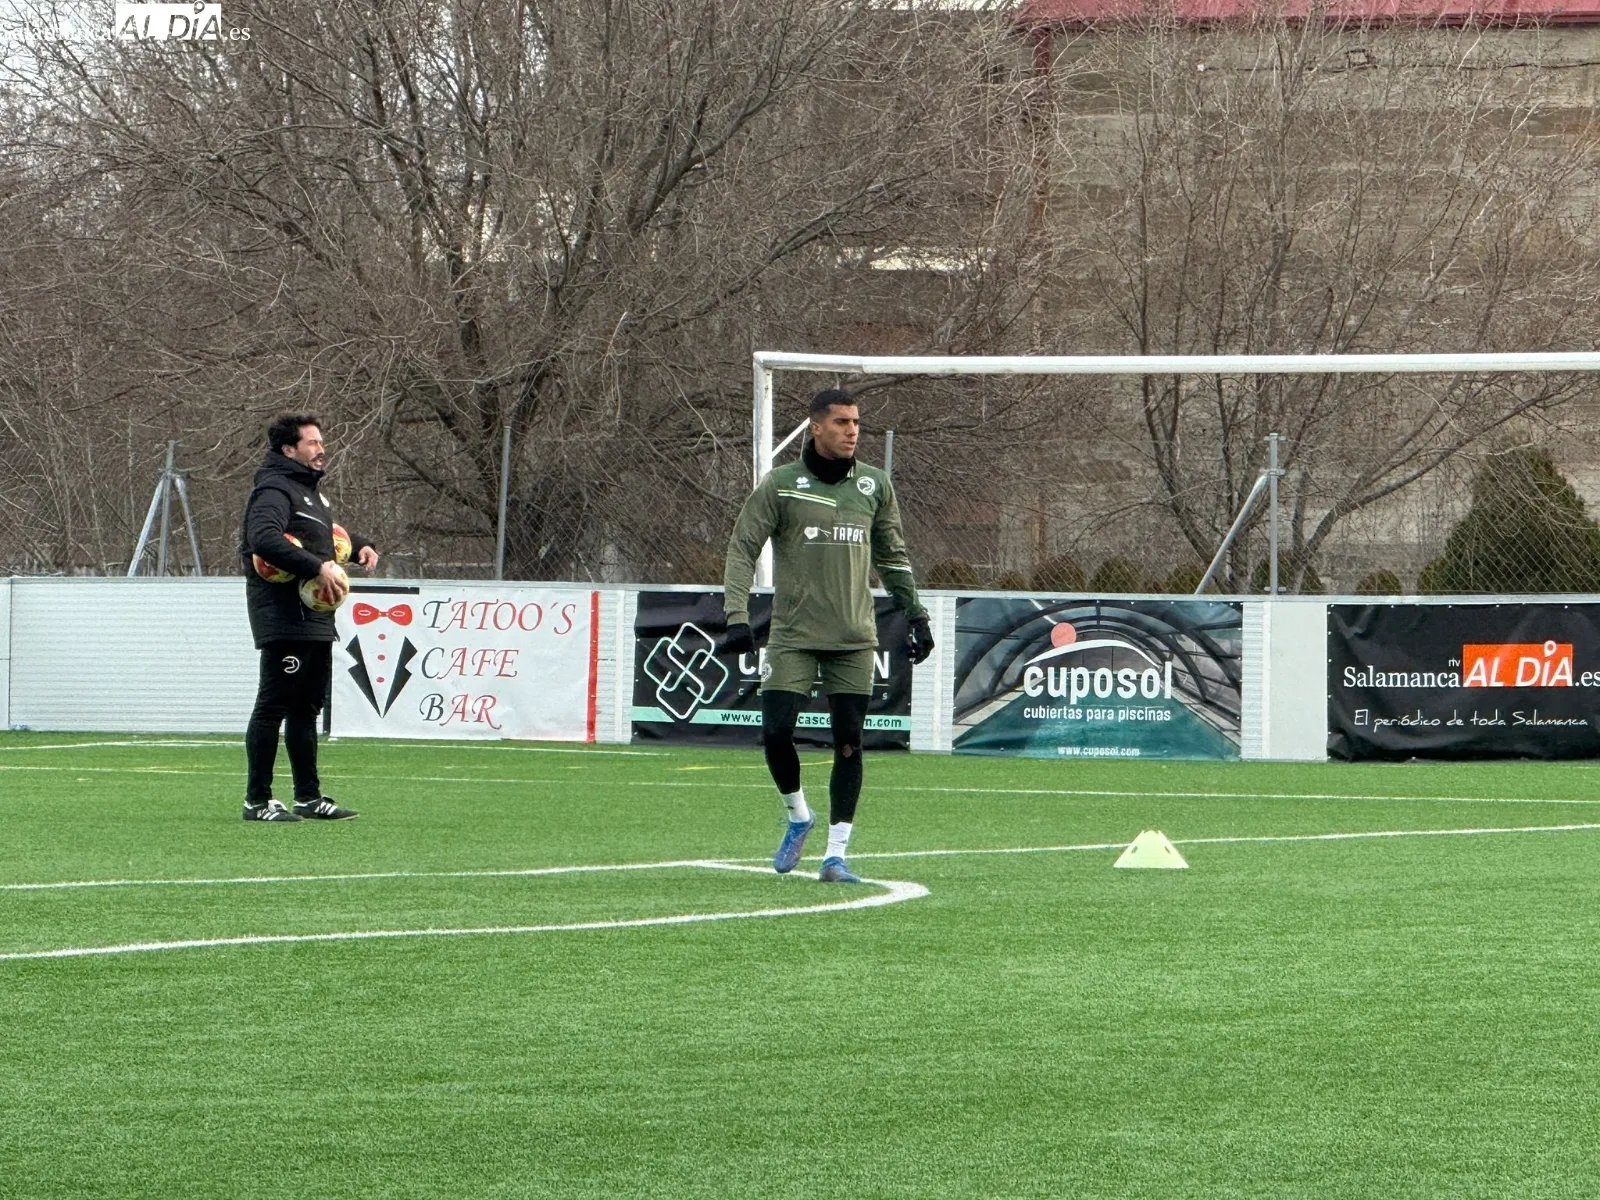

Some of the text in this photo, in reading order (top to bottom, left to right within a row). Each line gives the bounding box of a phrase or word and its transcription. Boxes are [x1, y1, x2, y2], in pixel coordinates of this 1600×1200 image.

[421, 646, 519, 680] CAFE
[1343, 665, 1461, 688] Salamanca
[1463, 656, 1505, 687] AL
[1023, 661, 1173, 705] cuposol
[419, 693, 502, 730] BAR
[1023, 706, 1171, 722] cubiertas para piscinas
[1354, 708, 1588, 733] El periódico de toda Salamanca
[1057, 745, 1140, 758] www.cuposol.com
